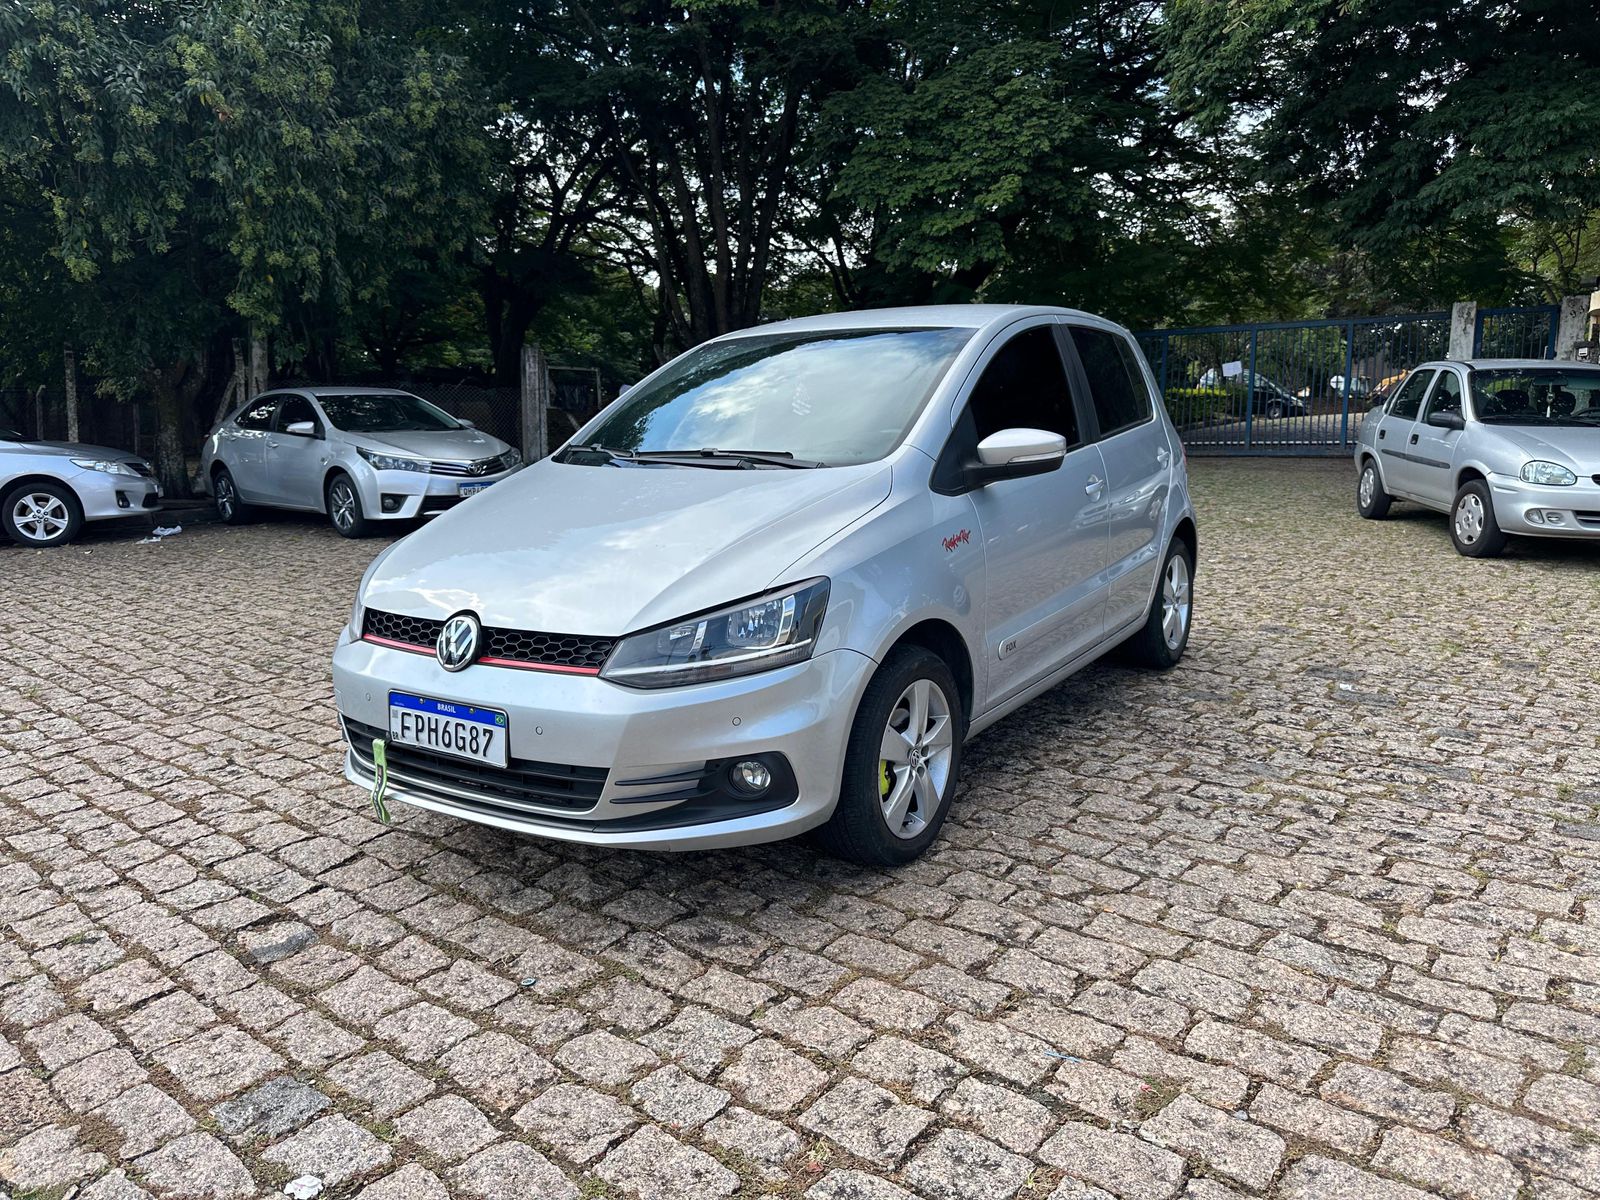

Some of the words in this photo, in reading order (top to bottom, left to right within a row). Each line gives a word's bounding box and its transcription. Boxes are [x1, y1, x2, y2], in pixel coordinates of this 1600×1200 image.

[1005, 640, 1016, 653] FOX
[436, 702, 457, 714] BRASIL
[400, 711, 494, 757] FPH6G87
